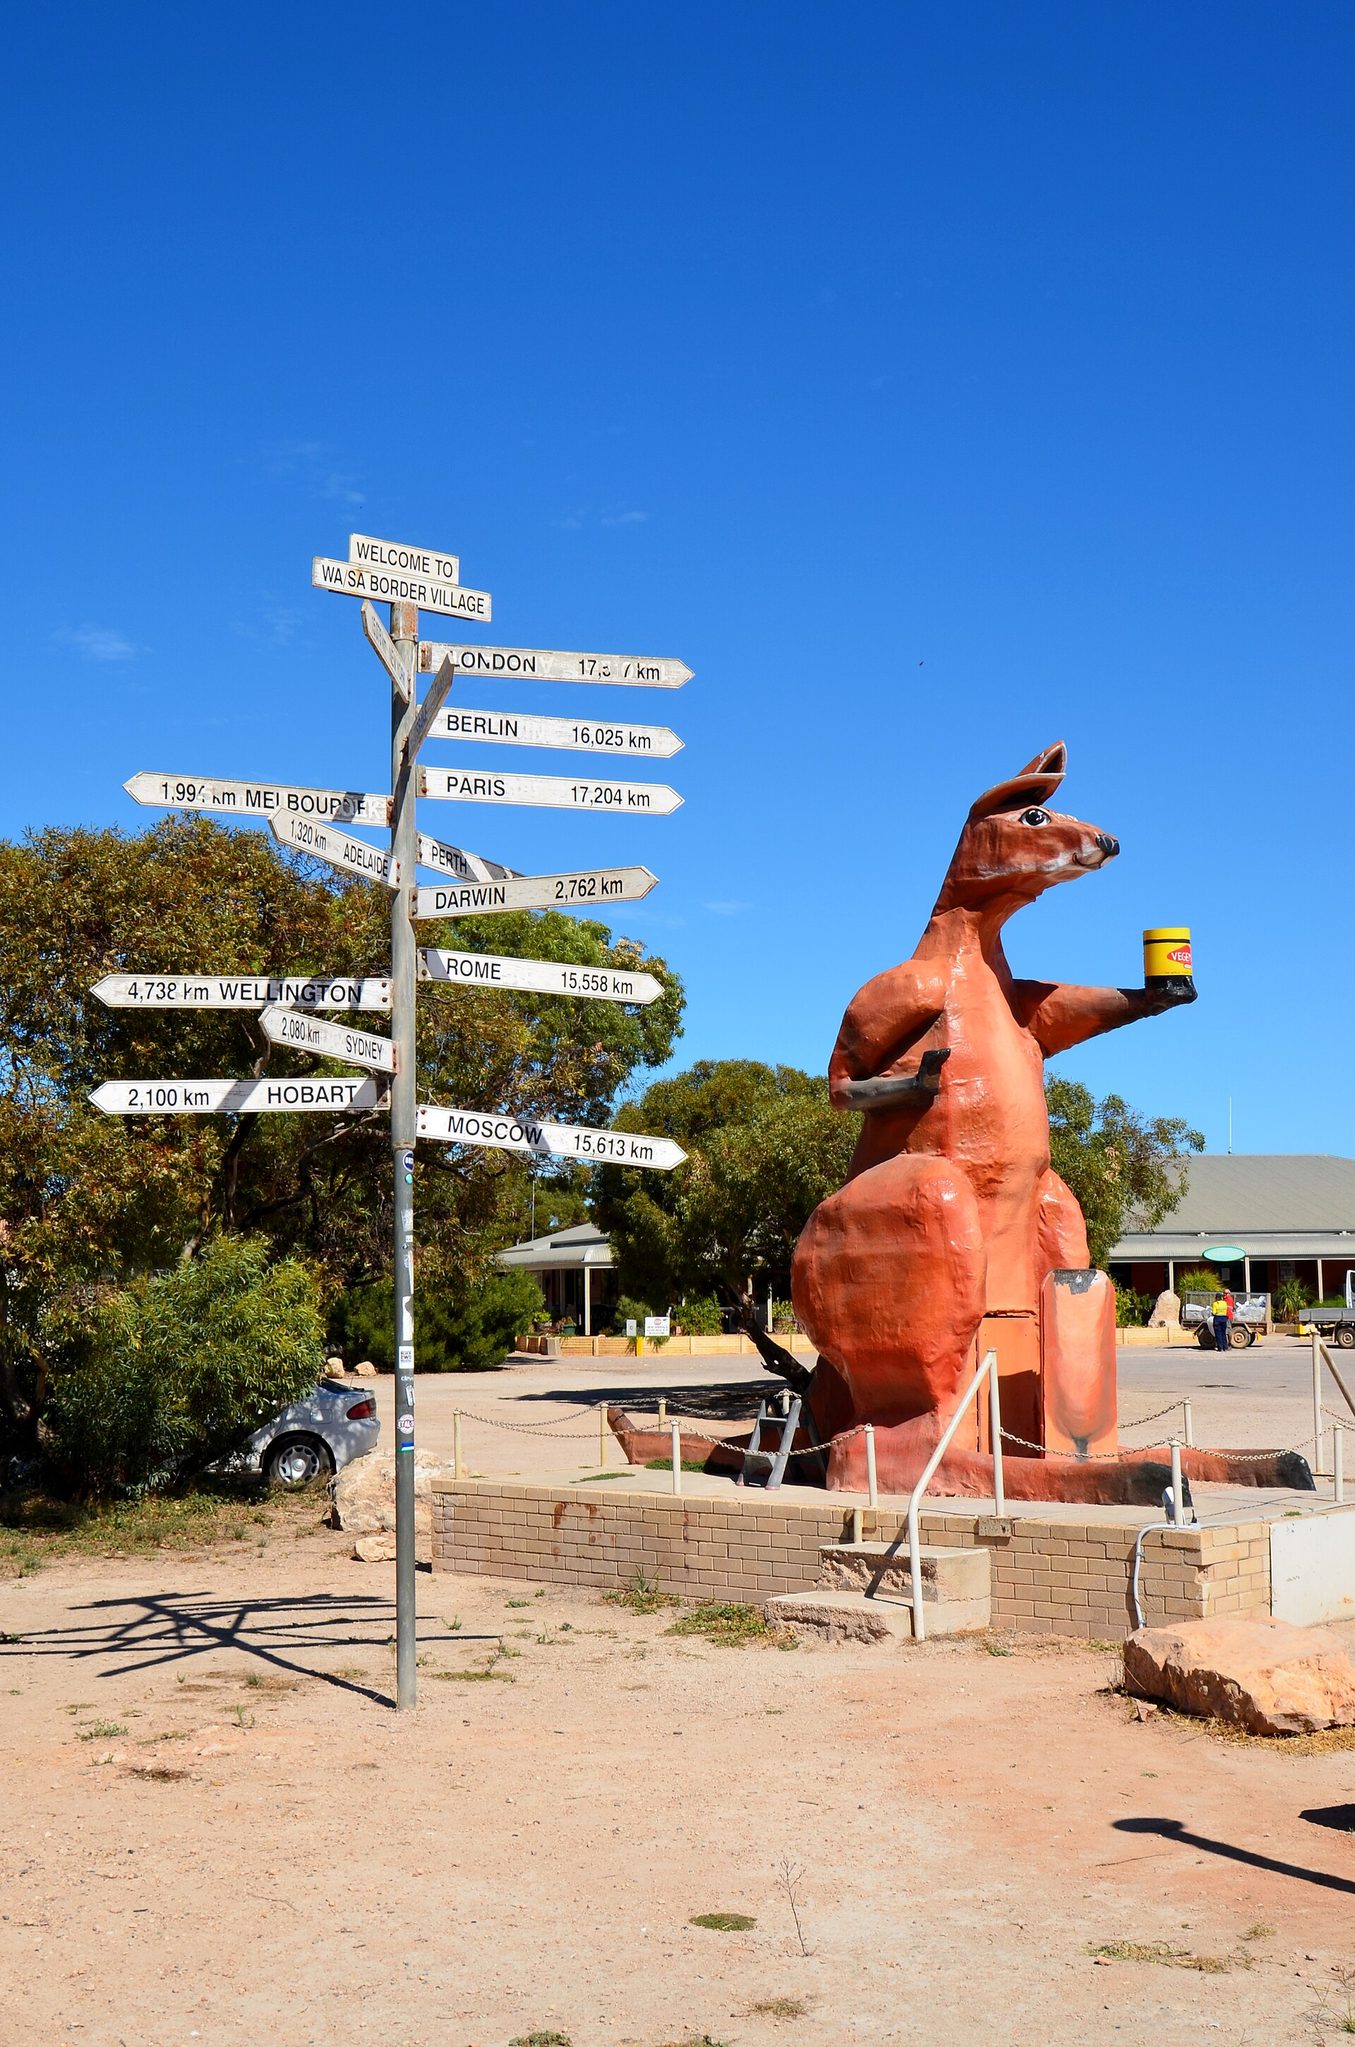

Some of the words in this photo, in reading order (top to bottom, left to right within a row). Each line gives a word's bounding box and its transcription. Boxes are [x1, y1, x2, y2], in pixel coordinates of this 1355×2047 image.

[356, 541, 430, 573] WELCOME
[435, 559, 453, 578] TO
[370, 575, 427, 602] BORDER
[430, 586, 485, 614] VILLAGE
[637, 663, 660, 681] km
[447, 714, 518, 737] BERLIN
[572, 726, 623, 747] 16,025
[629, 730, 651, 750] km
[245, 789, 366, 815] MELBOURE
[446, 776, 505, 797] PARIS
[570, 786, 622, 807] 17,204
[628, 788, 650, 807] km
[290, 818, 313, 846] 1,320
[314, 827, 327, 850] km
[343, 842, 389, 878] ADELAIDE
[431, 845, 468, 875] PERTH
[435, 886, 506, 910] DARWIN
[555, 877, 596, 902] 2,762
[601, 876, 623, 895] km
[1171, 951, 1191, 962] VEGE
[128, 981, 177, 1003] 4,738
[184, 982, 209, 1001] km
[219, 982, 362, 1003] WELLINGTON
[446, 957, 501, 980] ROME
[561, 971, 608, 993] 15,558
[612, 977, 633, 995] km
[281, 1017, 305, 1041] 2,080
[306, 1023, 320, 1045] km
[345, 1034, 383, 1061] SYDNEY
[128, 1088, 177, 1109] 2,100
[184, 1088, 209, 1106] km
[267, 1085, 357, 1104] HOBART
[447, 1115, 543, 1145] MOSCOW
[573, 1133, 625, 1157] 15,613
[631, 1141, 654, 1161] km
